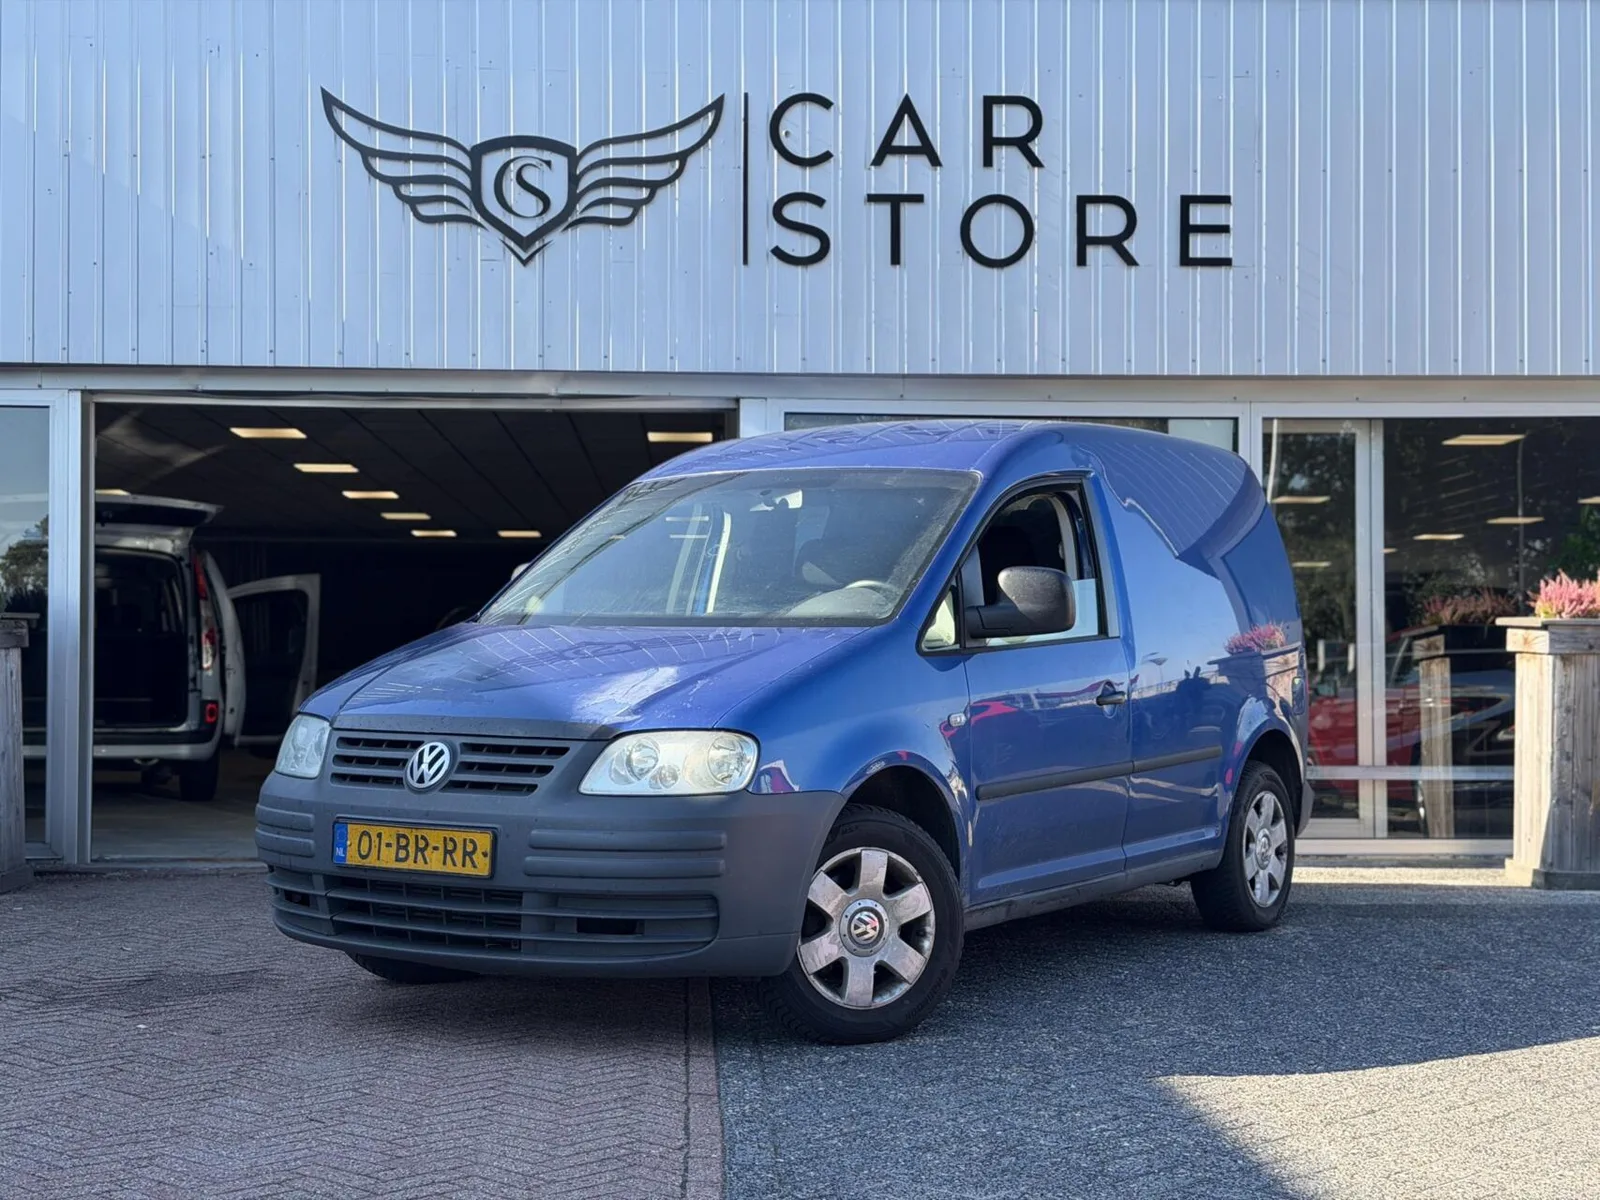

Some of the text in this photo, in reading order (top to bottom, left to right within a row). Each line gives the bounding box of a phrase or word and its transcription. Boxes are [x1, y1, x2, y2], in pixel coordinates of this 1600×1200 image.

[770, 93, 1044, 169] CAR
[771, 192, 1233, 269] STORE
[407, 742, 450, 788] VW
[336, 830, 478, 868] NL 01-BR-RR
